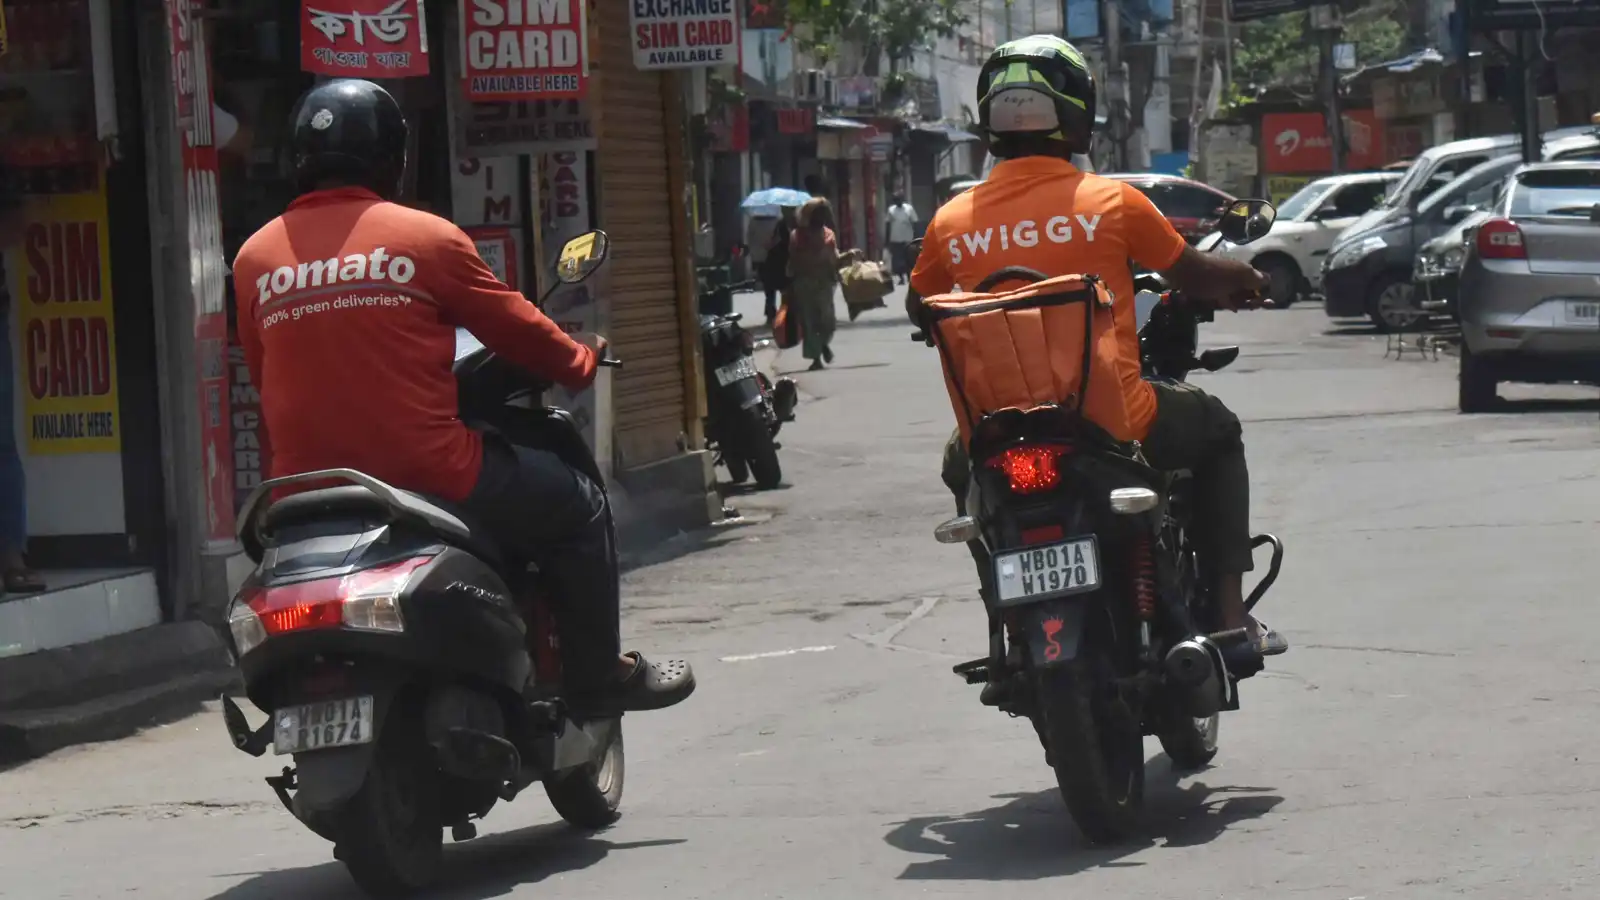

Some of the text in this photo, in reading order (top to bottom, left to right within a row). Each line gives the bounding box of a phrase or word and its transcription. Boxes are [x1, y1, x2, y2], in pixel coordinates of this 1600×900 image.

[306, 0, 413, 45] কার্ড
[472, 0, 571, 26] SIM
[634, 0, 732, 18] EXCHANGE
[468, 30, 578, 70] CARD
[636, 19, 733, 50] SIM CARD
[313, 47, 411, 68] পাওয়া যায়
[649, 48, 724, 65] AVAILABLE
[471, 74, 579, 93] AVAILABLE HERE
[949, 214, 1101, 264] SWIGGY
[25, 221, 102, 305] SIM
[256, 247, 415, 305] zomato
[263, 293, 400, 329] 100% green deliveries
[27, 315, 110, 400] CARD
[32, 412, 113, 441] AVAILABLE HERE
[1020, 543, 1085, 574] WB01A
[1022, 565, 1087, 595] W1970
